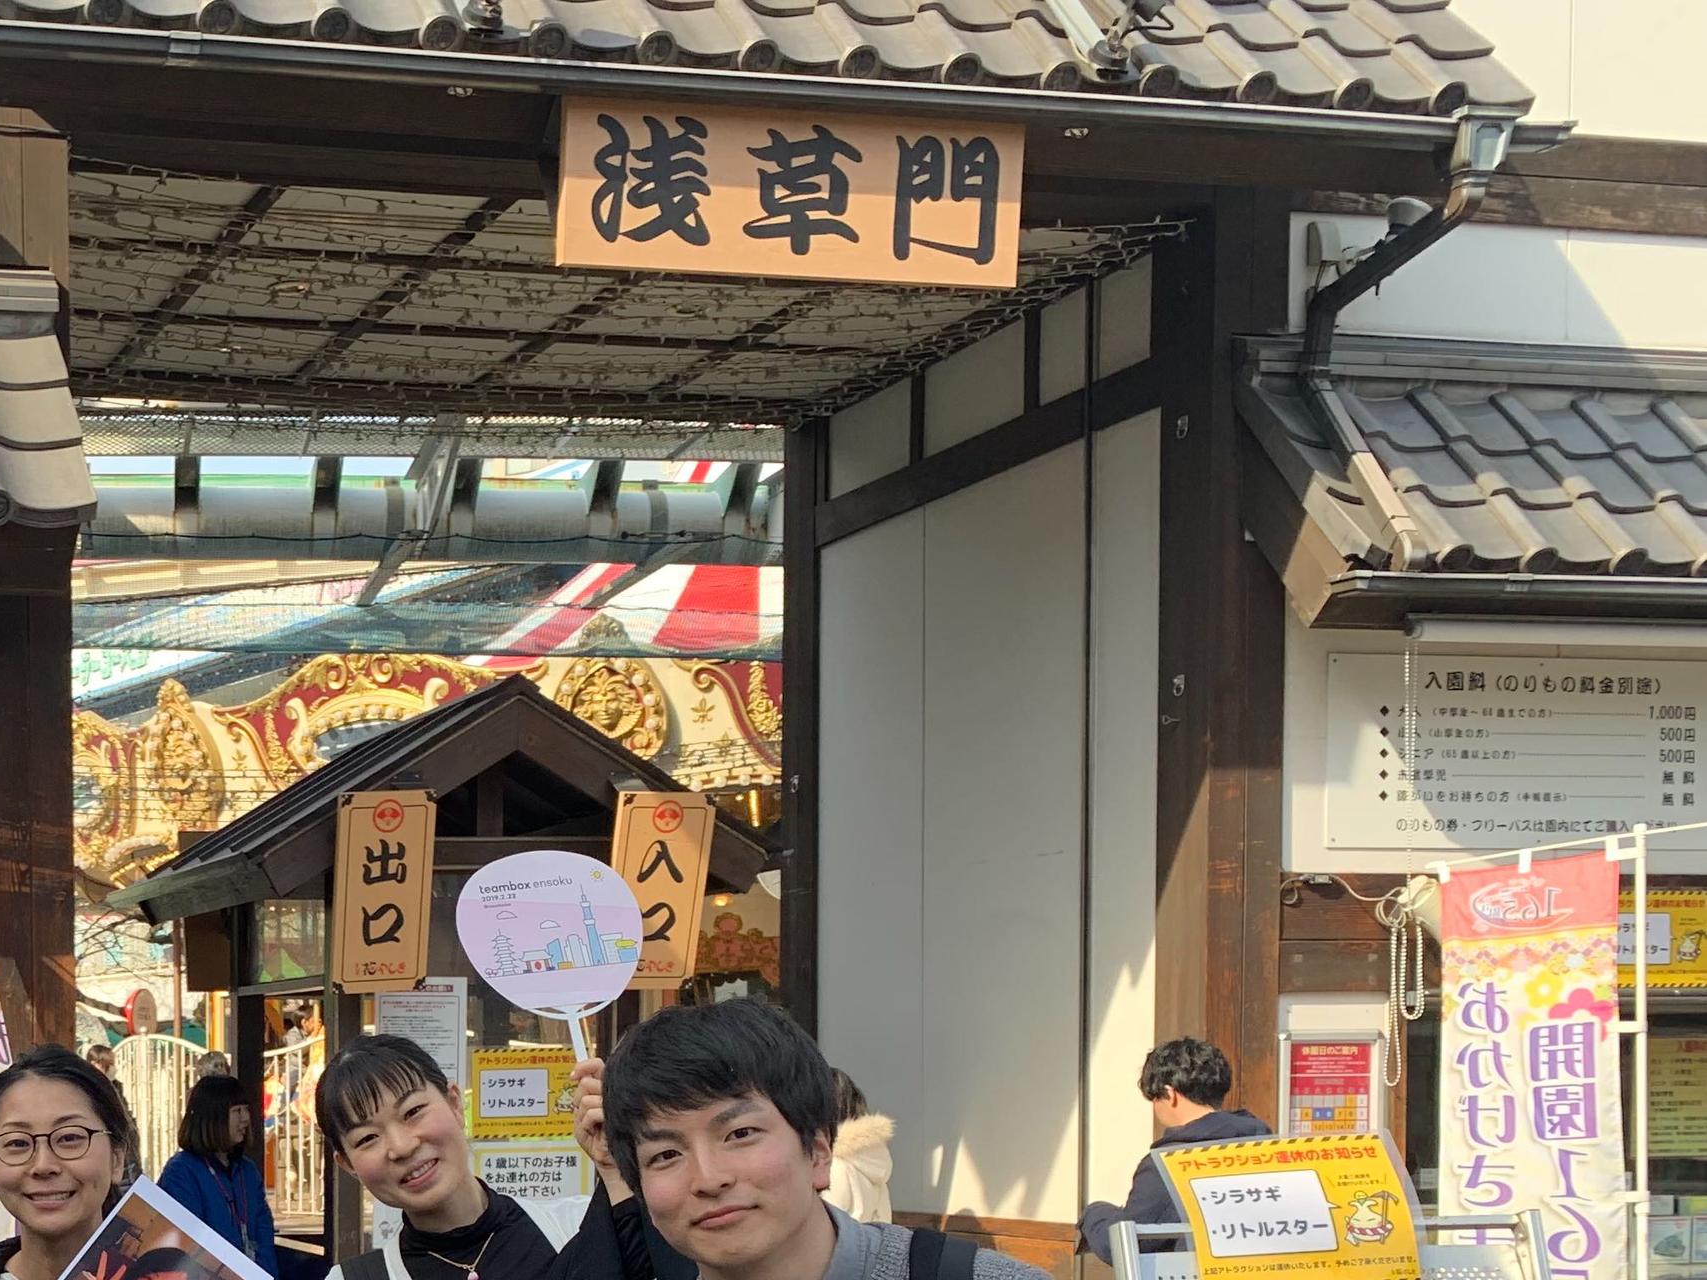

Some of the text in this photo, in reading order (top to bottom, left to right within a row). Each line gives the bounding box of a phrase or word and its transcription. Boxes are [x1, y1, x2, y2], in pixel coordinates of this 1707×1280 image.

[591, 114, 1000, 265] 浅草門
[1648, 705, 1696, 721] 1,000円
[1659, 727, 1696, 742] 500円
[1659, 748, 1696, 764] 500円
[362, 839, 407, 947] 出口
[479, 875, 573, 895] teambox ensoku
[637, 840, 684, 942] 入口
[1178, 1145, 1378, 1172] アトラクション運休のお知らせ
